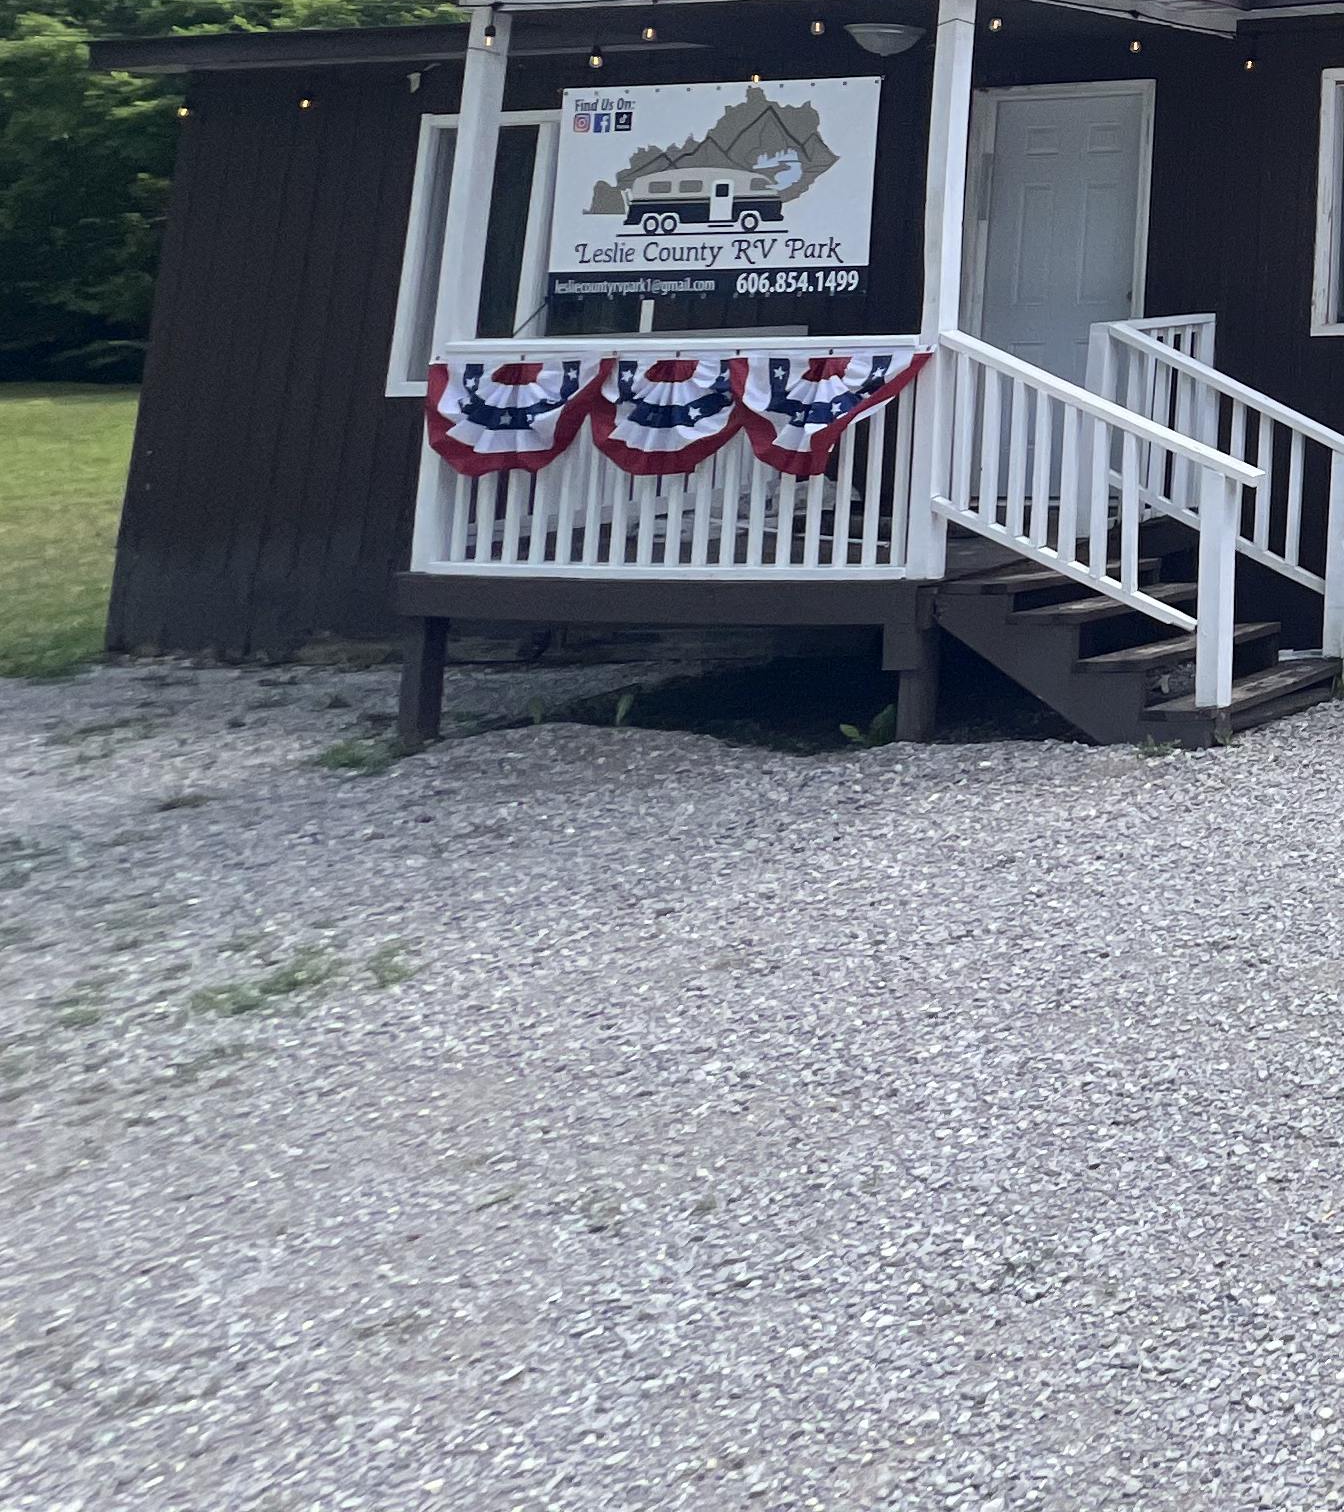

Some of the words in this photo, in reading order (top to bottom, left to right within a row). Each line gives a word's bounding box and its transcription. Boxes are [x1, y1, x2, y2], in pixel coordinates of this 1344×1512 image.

[574, 98, 600, 112] Find
[601, 98, 615, 111] Us
[616, 97, 637, 111] On:
[574, 243, 636, 265] Leslie
[643, 240, 723, 267] County
[731, 238, 778, 265] RV
[784, 236, 844, 265] Park
[554, 276, 716, 297] lesliecountyrvpark1@gmail.com
[735, 270, 860, 295] 606.854.1499
